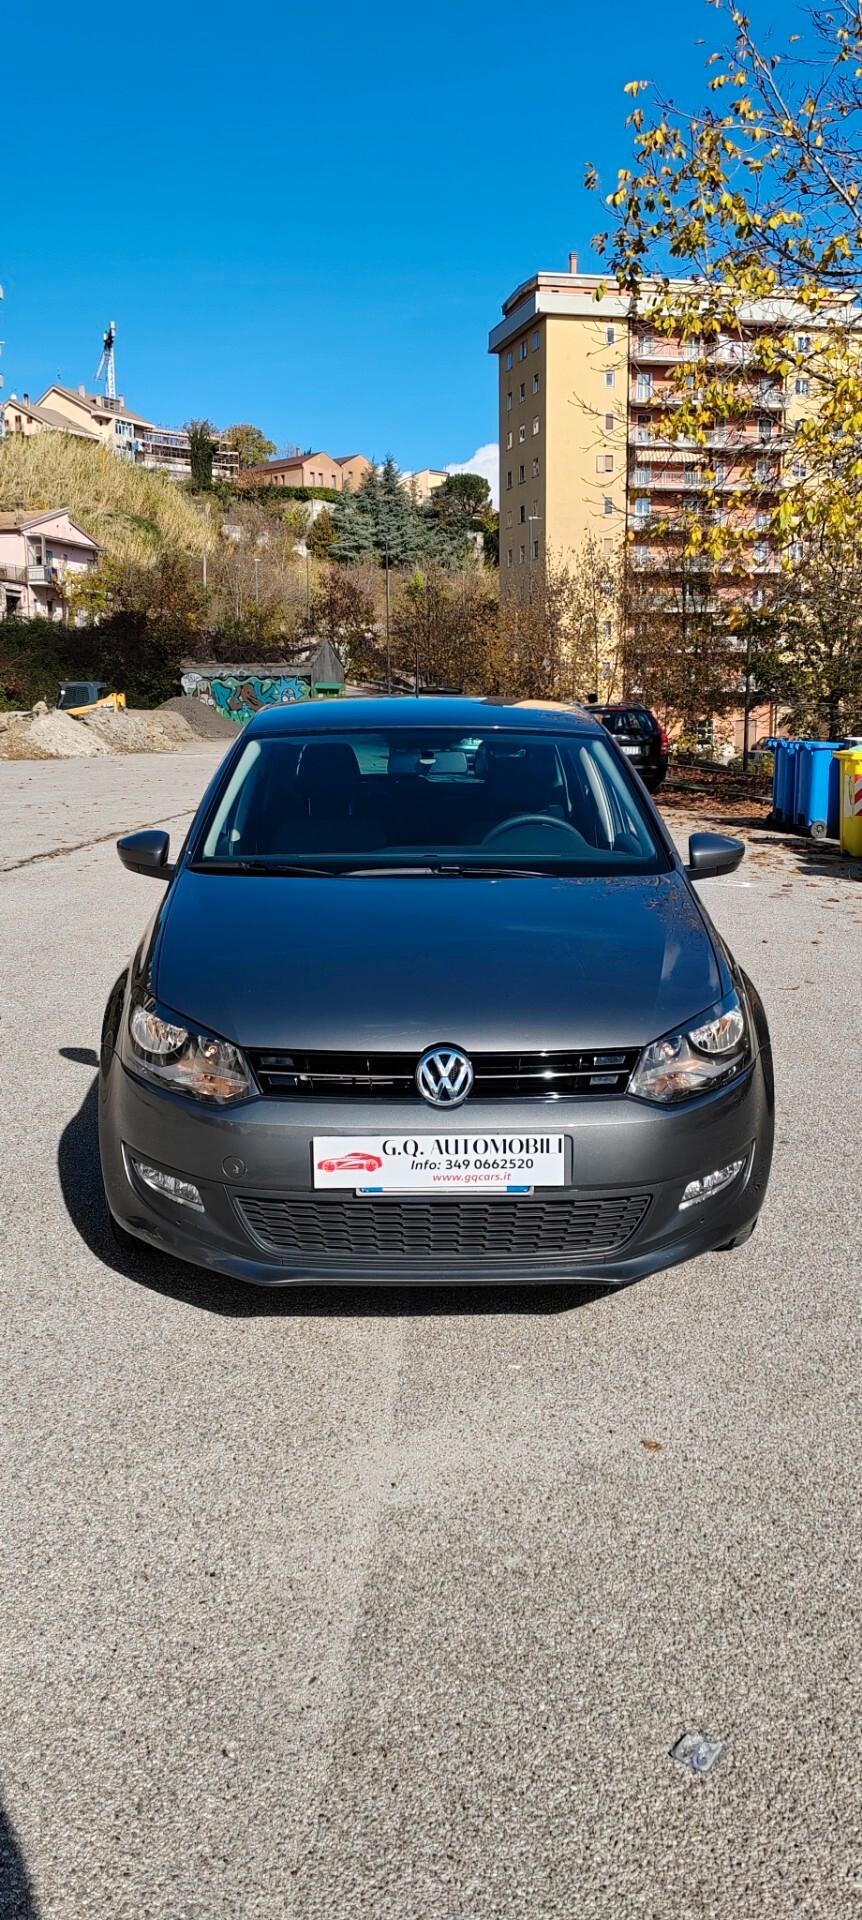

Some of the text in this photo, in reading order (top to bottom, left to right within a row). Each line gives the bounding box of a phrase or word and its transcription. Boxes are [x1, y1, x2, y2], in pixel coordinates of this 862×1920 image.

[420, 1051, 471, 1102] VW
[382, 1138, 562, 1157] G.Q. AUTOMOBILI
[411, 1158, 534, 1170] Info: 349 0662520
[432, 1172, 512, 1183] www.gqcars.it
